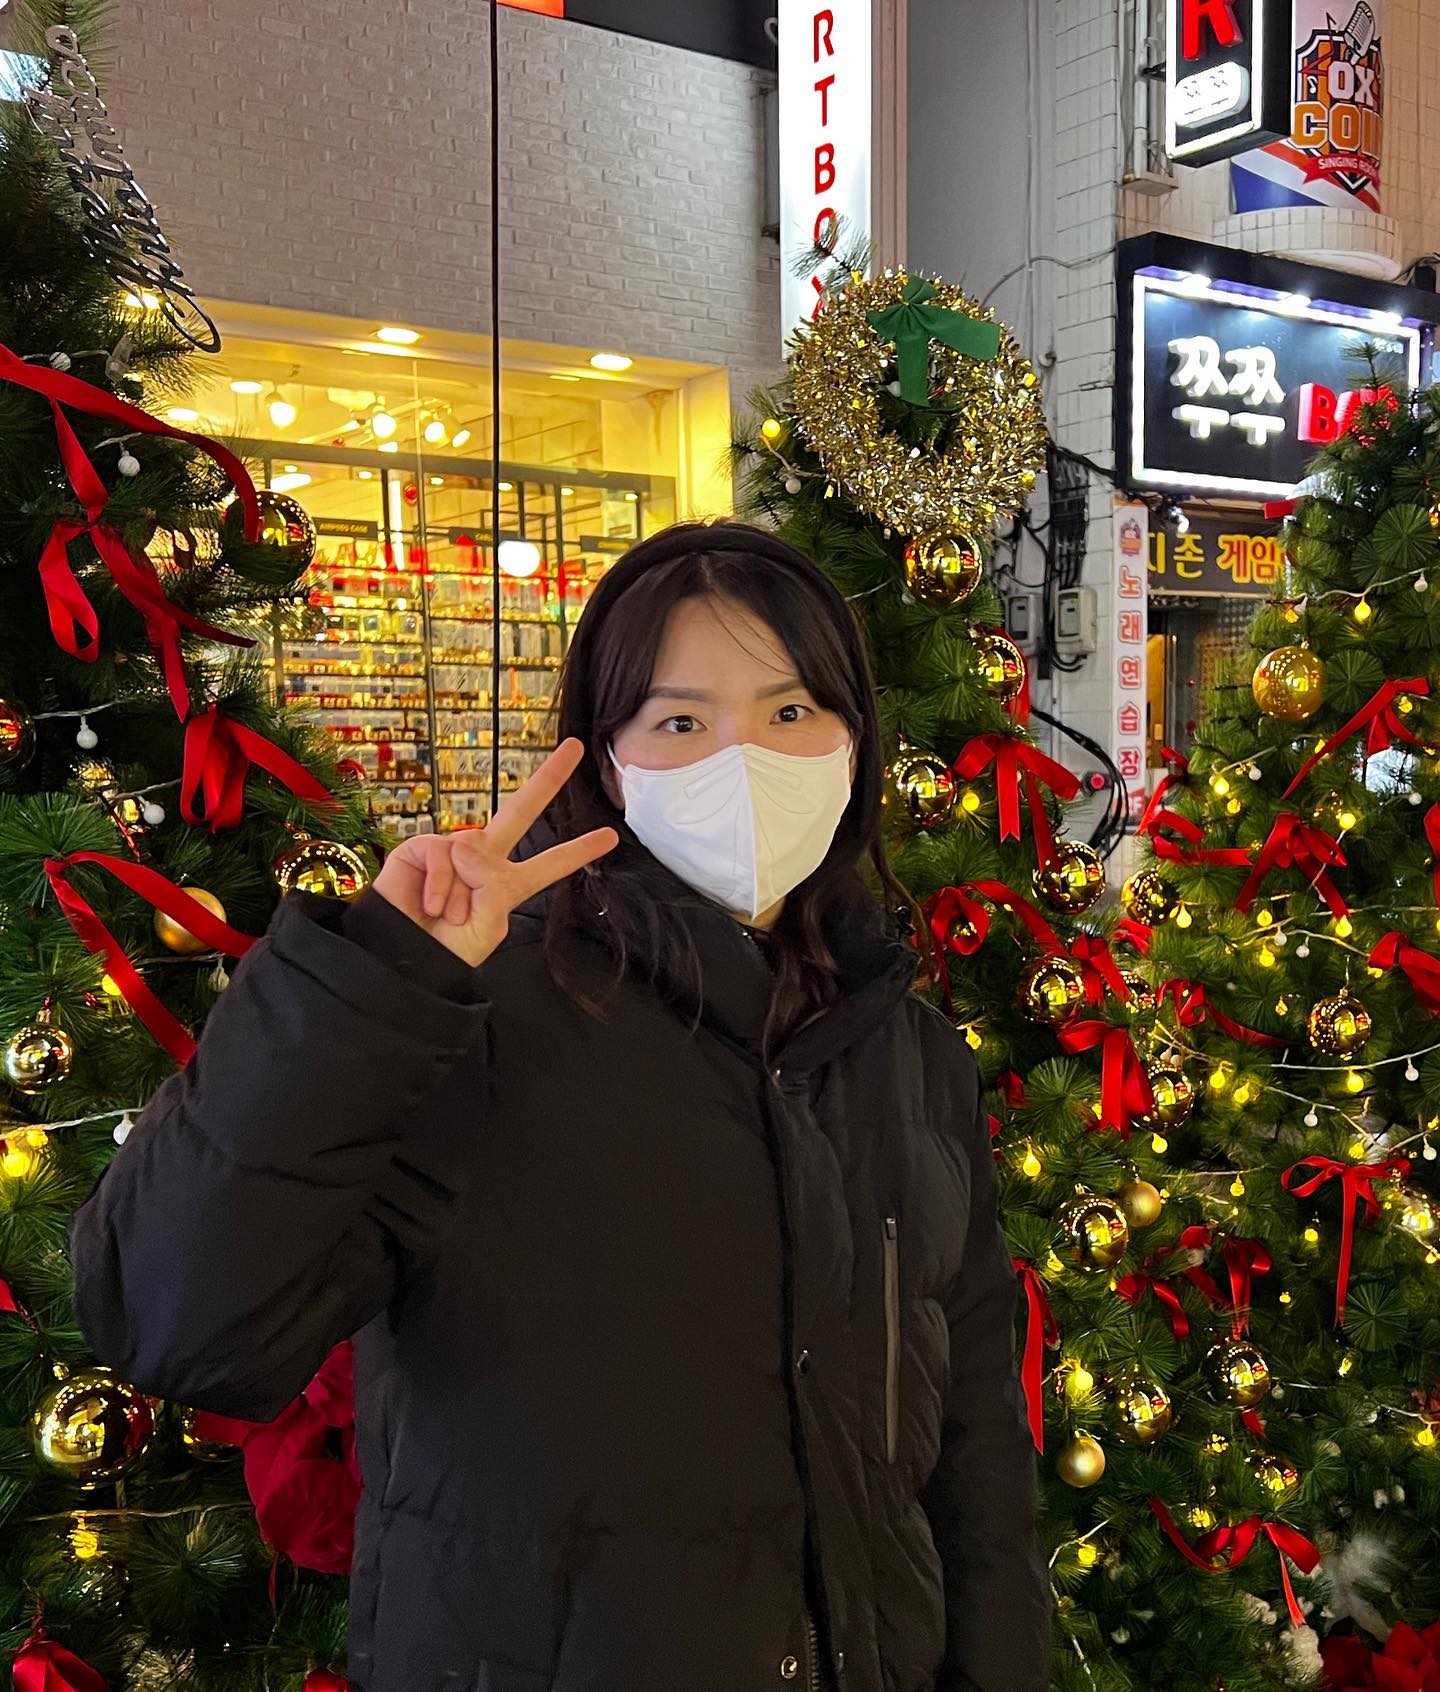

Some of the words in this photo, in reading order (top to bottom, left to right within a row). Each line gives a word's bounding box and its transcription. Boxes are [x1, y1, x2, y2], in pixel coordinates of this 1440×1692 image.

[1318, 156, 1358, 169] SINGING
[1168, 335, 1287, 446] 쭈쭈
[1117, 565, 1143, 778] 노래연습장
